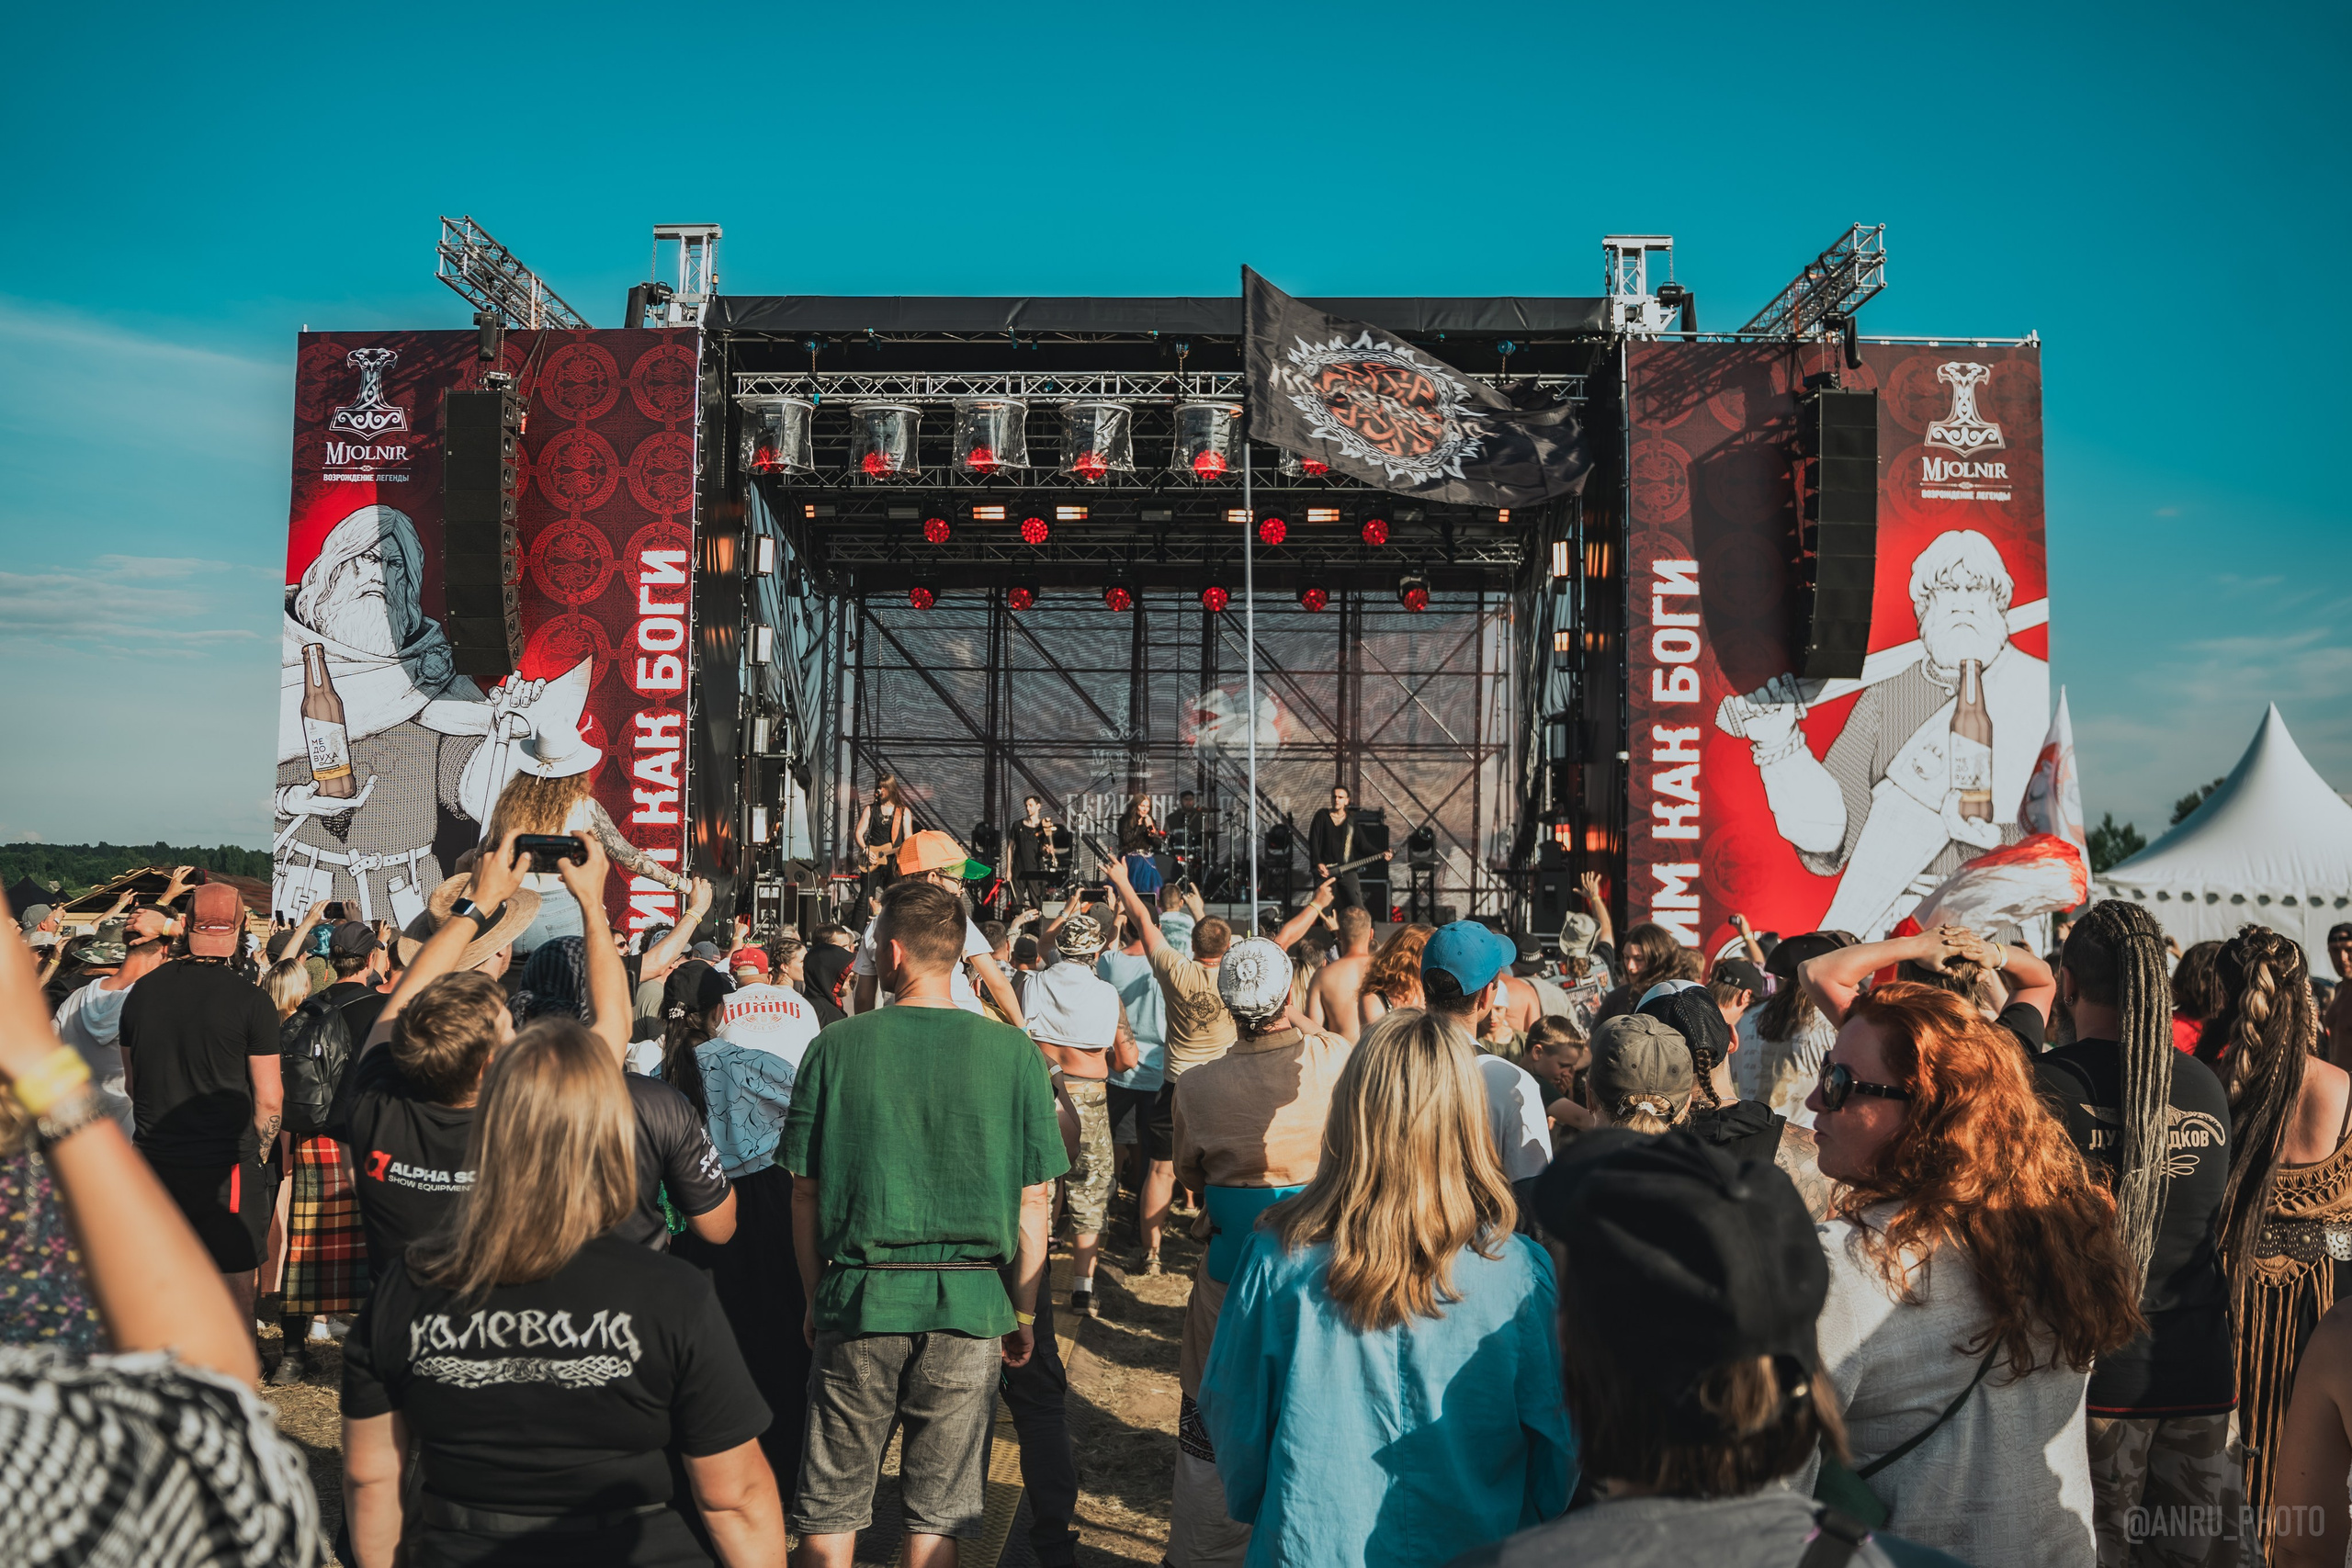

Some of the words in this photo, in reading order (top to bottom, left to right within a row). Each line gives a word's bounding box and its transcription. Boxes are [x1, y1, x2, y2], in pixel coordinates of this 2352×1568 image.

[324, 441, 410, 465] MJOLNIR
[322, 473, 374, 482] ВОЗРОЖДЕНИЕ
[376, 474, 410, 482] ЛЕГЕНДЫ
[1921, 456, 2009, 481] MJOLNIR
[636, 550, 686, 690] БОГИ
[1651, 558, 1701, 703] БОГИ
[311, 738, 323, 747] МЕ
[313, 746, 326, 754] ДО
[632, 712, 682, 824] КАК
[1651, 725, 1701, 840] КАК
[388, 1174, 416, 1188] SHOW
[390, 1161, 451, 1183] ALPHA
